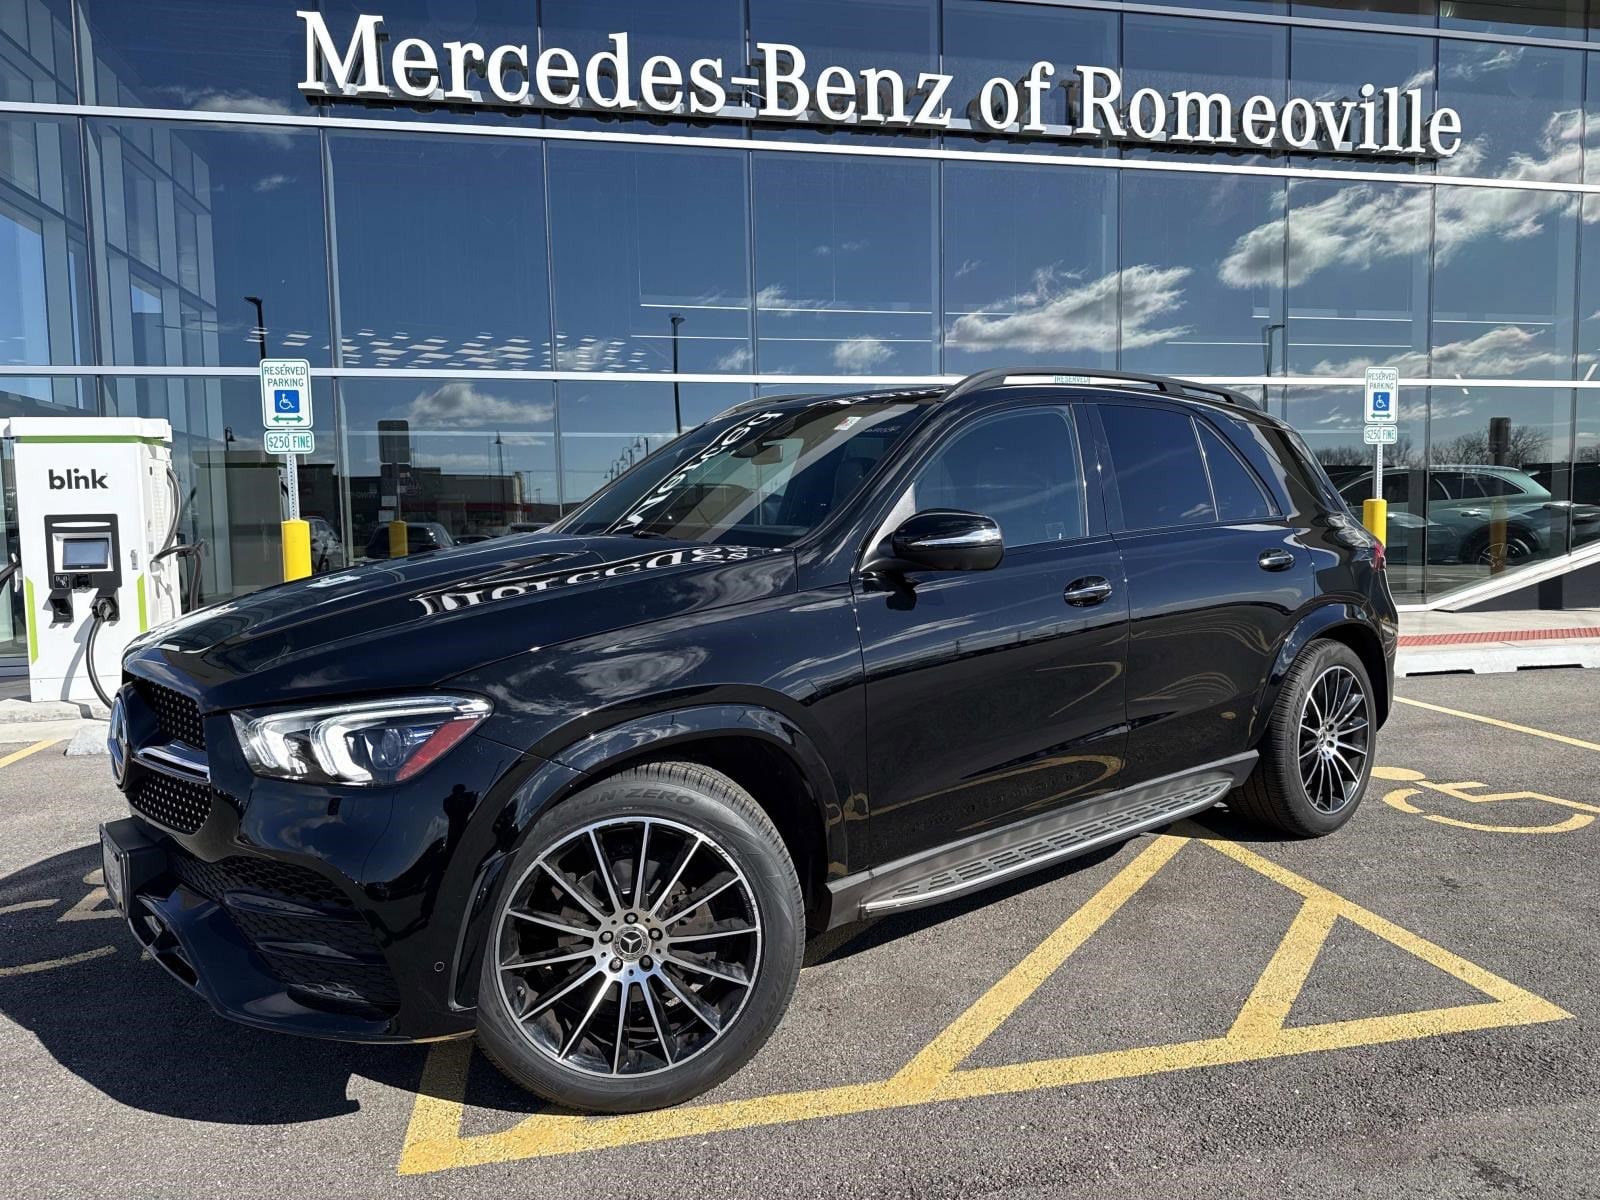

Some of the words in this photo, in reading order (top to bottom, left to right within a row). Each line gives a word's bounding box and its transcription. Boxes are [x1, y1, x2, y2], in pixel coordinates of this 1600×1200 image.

[297, 11, 953, 126] Mercedes-Benz
[979, 61, 1054, 132] of
[1074, 65, 1462, 156] Romeoville
[264, 366, 306, 376] RESERVED
[1368, 372, 1396, 381] RESERVED
[267, 378, 304, 387] PARKING
[1369, 382, 1394, 390] PARKING
[1382, 429, 1396, 440] FINE
[268, 435, 290, 449] $250
[292, 435, 311, 449] FINE
[48, 468, 109, 490] blink
[624, 787, 696, 806] ZERO
